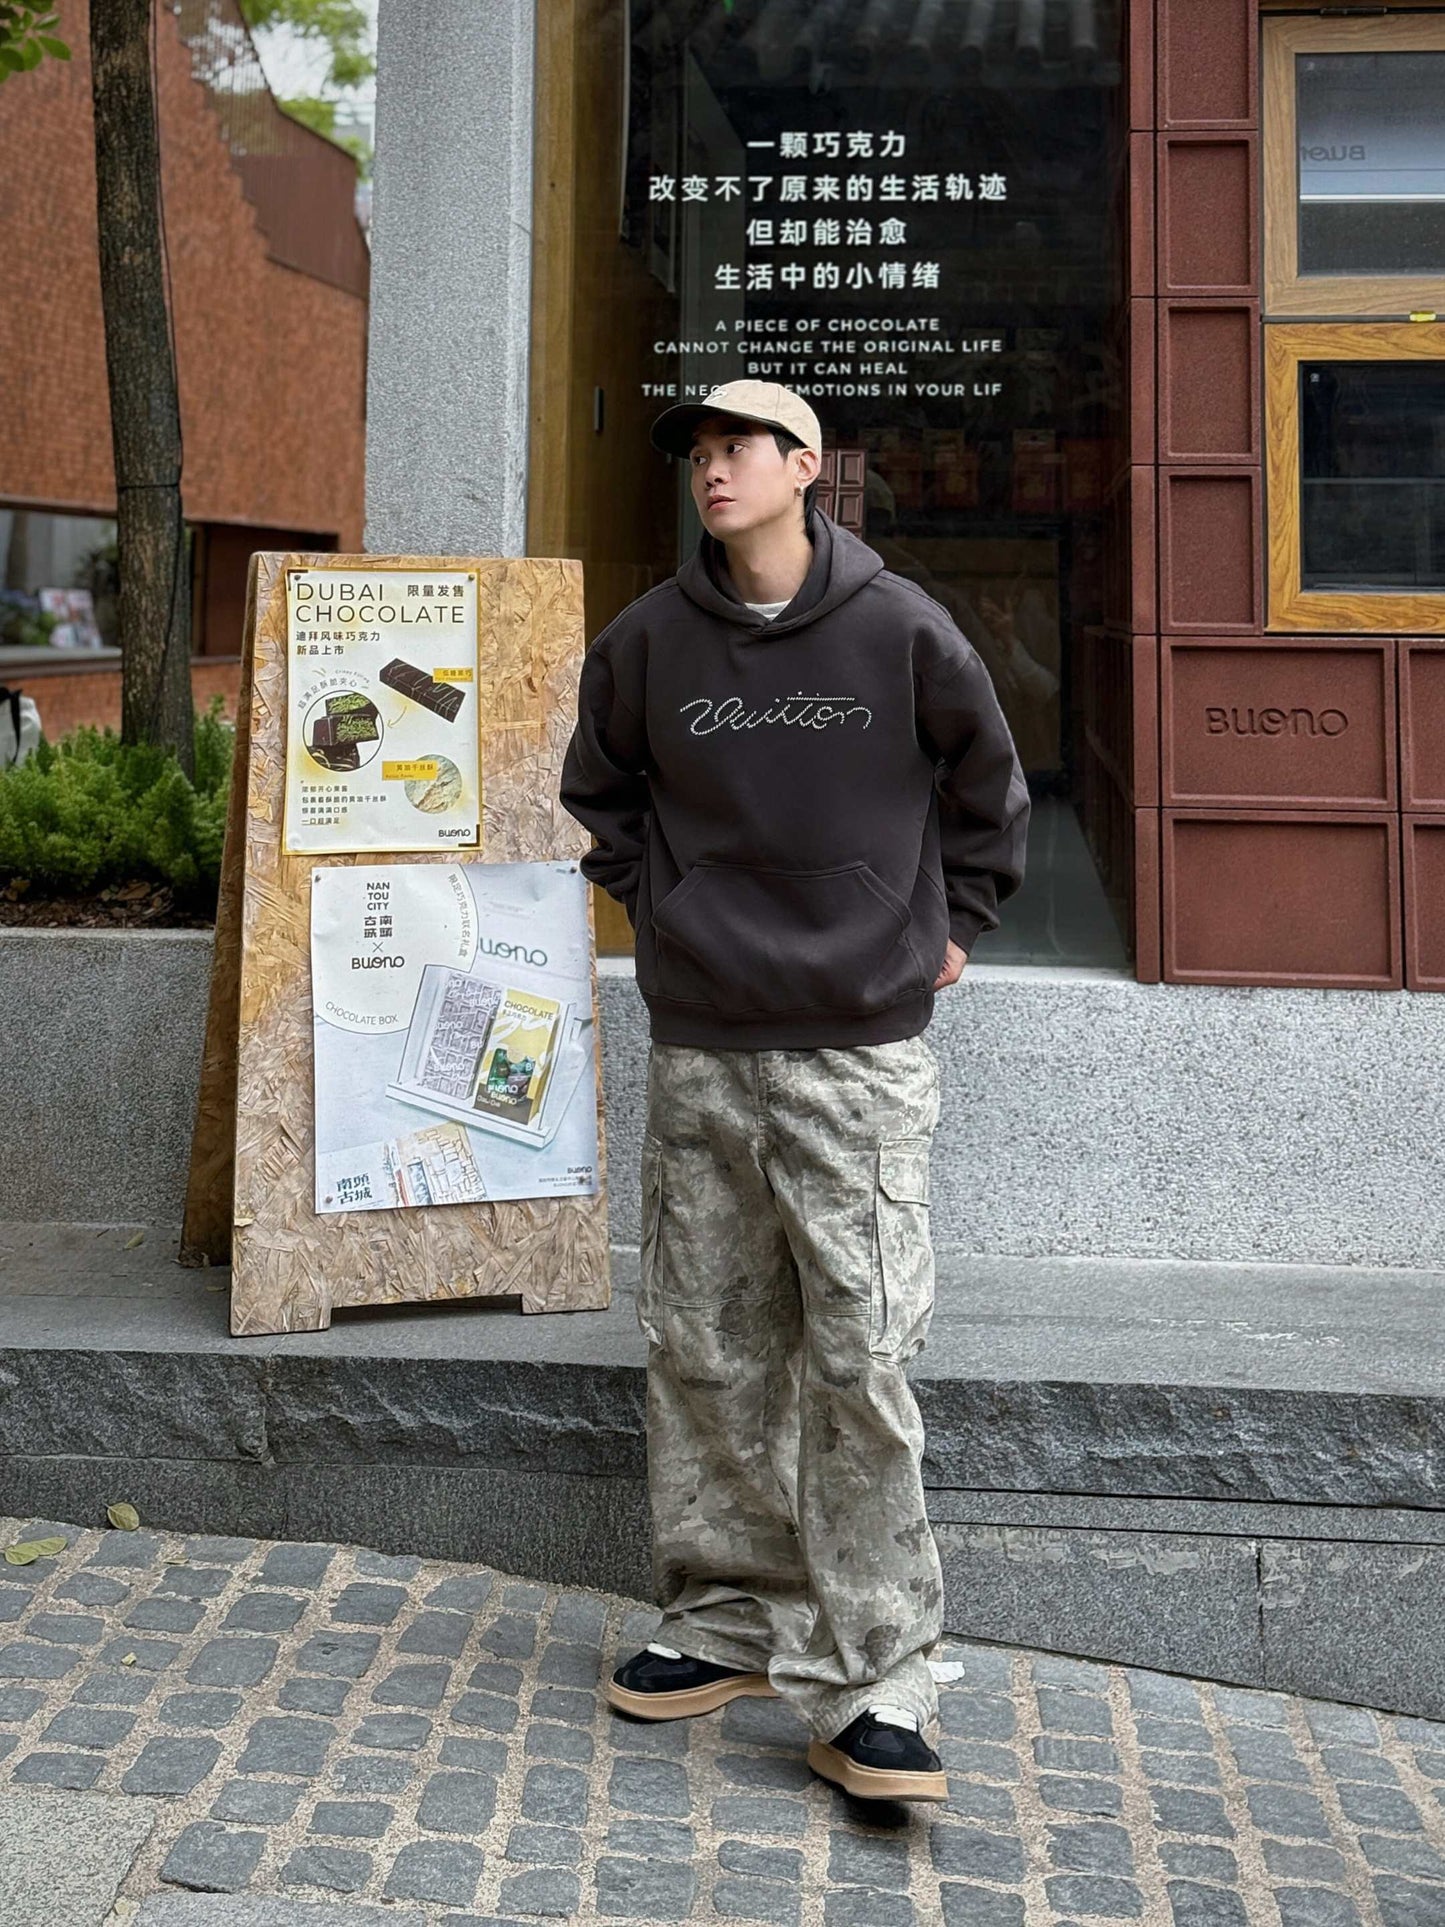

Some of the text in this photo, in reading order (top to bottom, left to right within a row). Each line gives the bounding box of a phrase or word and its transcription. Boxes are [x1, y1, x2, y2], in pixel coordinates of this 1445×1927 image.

[747, 130, 906, 158] 一颗巧克力
[649, 173, 1007, 202] 改变不了原来的生活轨迹
[746, 217, 907, 246] 但却能治愈
[714, 261, 941, 291] 生活中的小情绪
[715, 318, 939, 332] A PIECE OF CHOCOLATE
[654, 339, 1002, 354] CANNOT CHANGE THE ORIGINAL LIFE
[748, 362, 908, 375] BUT IT CAN HEAL
[641, 384, 677, 397] THE
[888, 383, 907, 396] IN
[915, 383, 965, 397] YOUR
[297, 583, 383, 601] DUBAI
[407, 584, 464, 597] 限量发售
[296, 605, 464, 623] CHOCOLATE
[296, 631, 380, 641] 迪拜风味巧克力
[296, 645, 345, 655] 新品上市
[366, 882, 390, 890] NAN
[367, 892, 389, 901] TOU
[366, 902, 389, 911] CITY
[325, 1001, 398, 1025] CHOCOLATE BOX
[504, 1000, 553, 1021] CHOCOLATE
